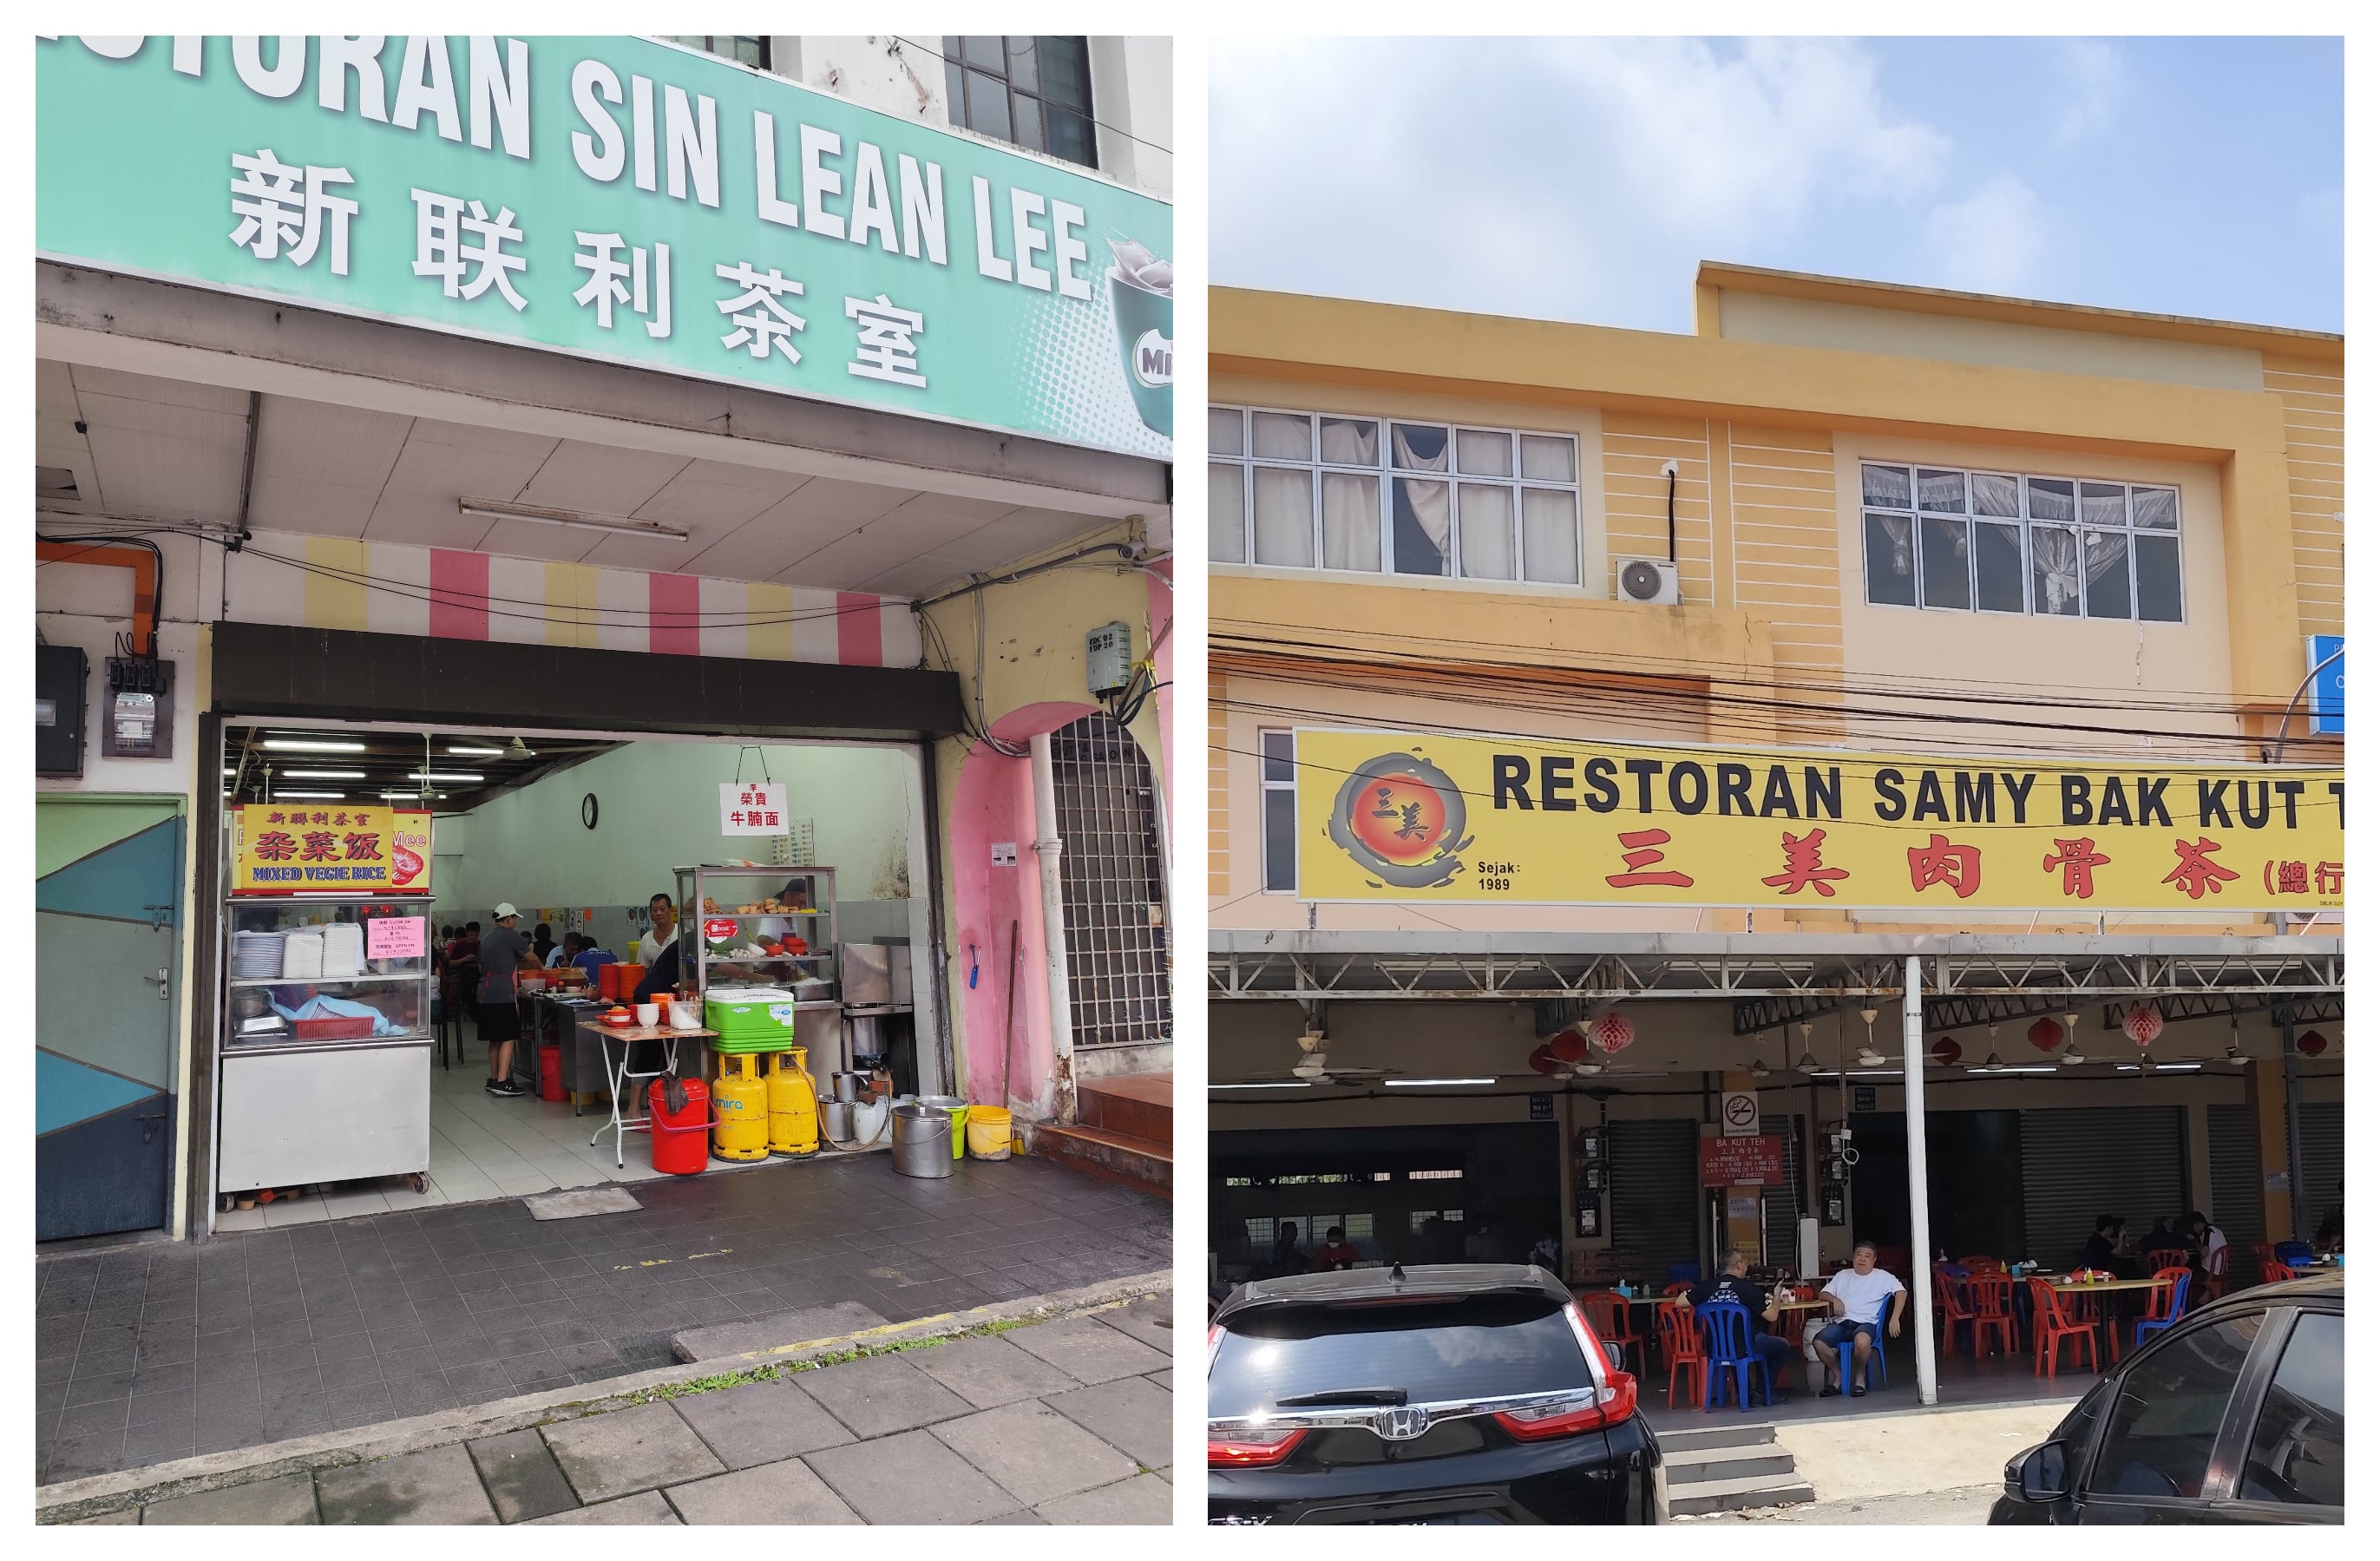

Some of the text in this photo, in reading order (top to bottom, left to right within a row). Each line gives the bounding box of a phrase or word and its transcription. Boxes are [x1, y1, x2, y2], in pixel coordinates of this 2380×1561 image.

[36, 36, 1092, 302] ORAN SIN LEAN LEE
[227, 148, 928, 389] 新联利茶室
[1103, 633, 1113, 642] 02
[740, 792, 767, 806] 榮貴
[1492, 754, 1843, 818] RESTORAN
[1873, 768, 2036, 823] SAMY
[2060, 774, 2174, 828] BAK
[2199, 778, 2305, 830] KUT
[731, 810, 779, 827] 牛腩面
[1371, 787, 1431, 842] 三美
[255, 831, 384, 862] 杂菜饭
[1478, 861, 1521, 876] Sejak:
[1605, 829, 2240, 899] 三美肉骨茶
[252, 866, 387, 882] MIXED VEGIE RICE
[1478, 877, 1510, 891] 1989
[715, 1098, 744, 1110] mira
[1716, 1138, 1766, 1147] BA KUT TEH
